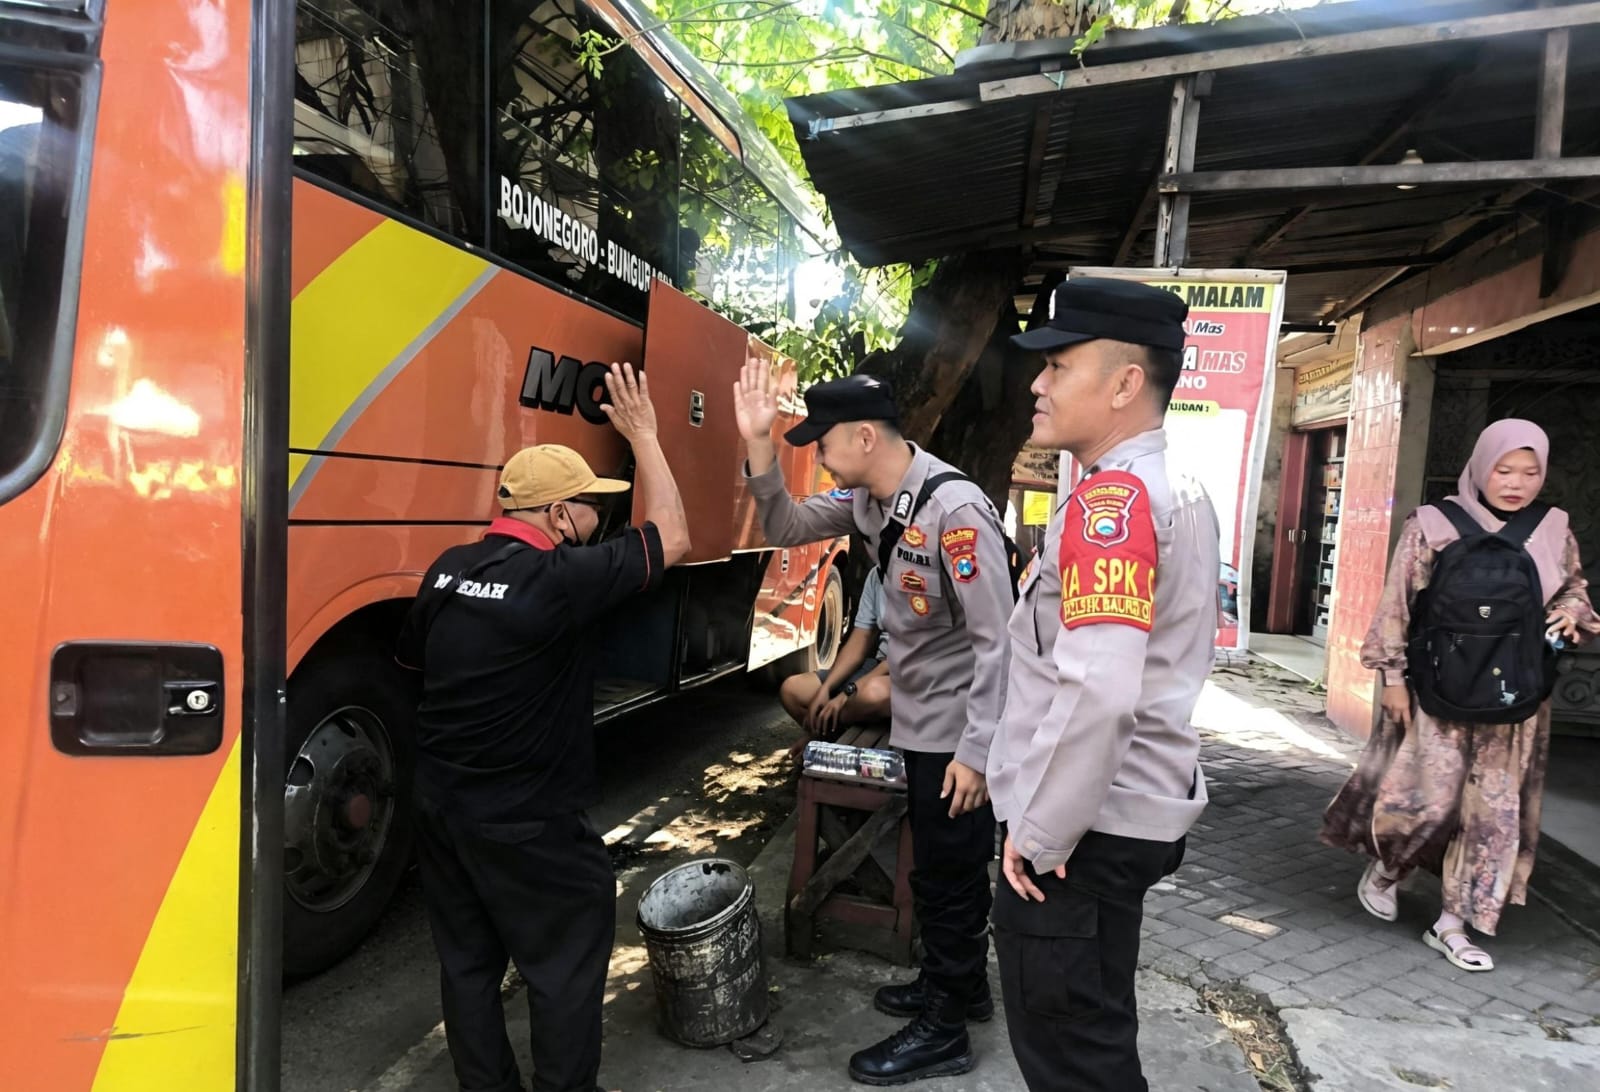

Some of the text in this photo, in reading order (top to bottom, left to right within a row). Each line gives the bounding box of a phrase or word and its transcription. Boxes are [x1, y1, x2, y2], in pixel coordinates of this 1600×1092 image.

[500, 175, 599, 266] BOJONEGORO
[607, 240, 673, 293] BUNGUR
[1187, 285, 1265, 308] MALAM
[1195, 321, 1224, 334] Mas
[1200, 350, 1247, 373] MAS
[1169, 402, 1204, 412] UJUAN
[1093, 557, 1138, 597] SPK
